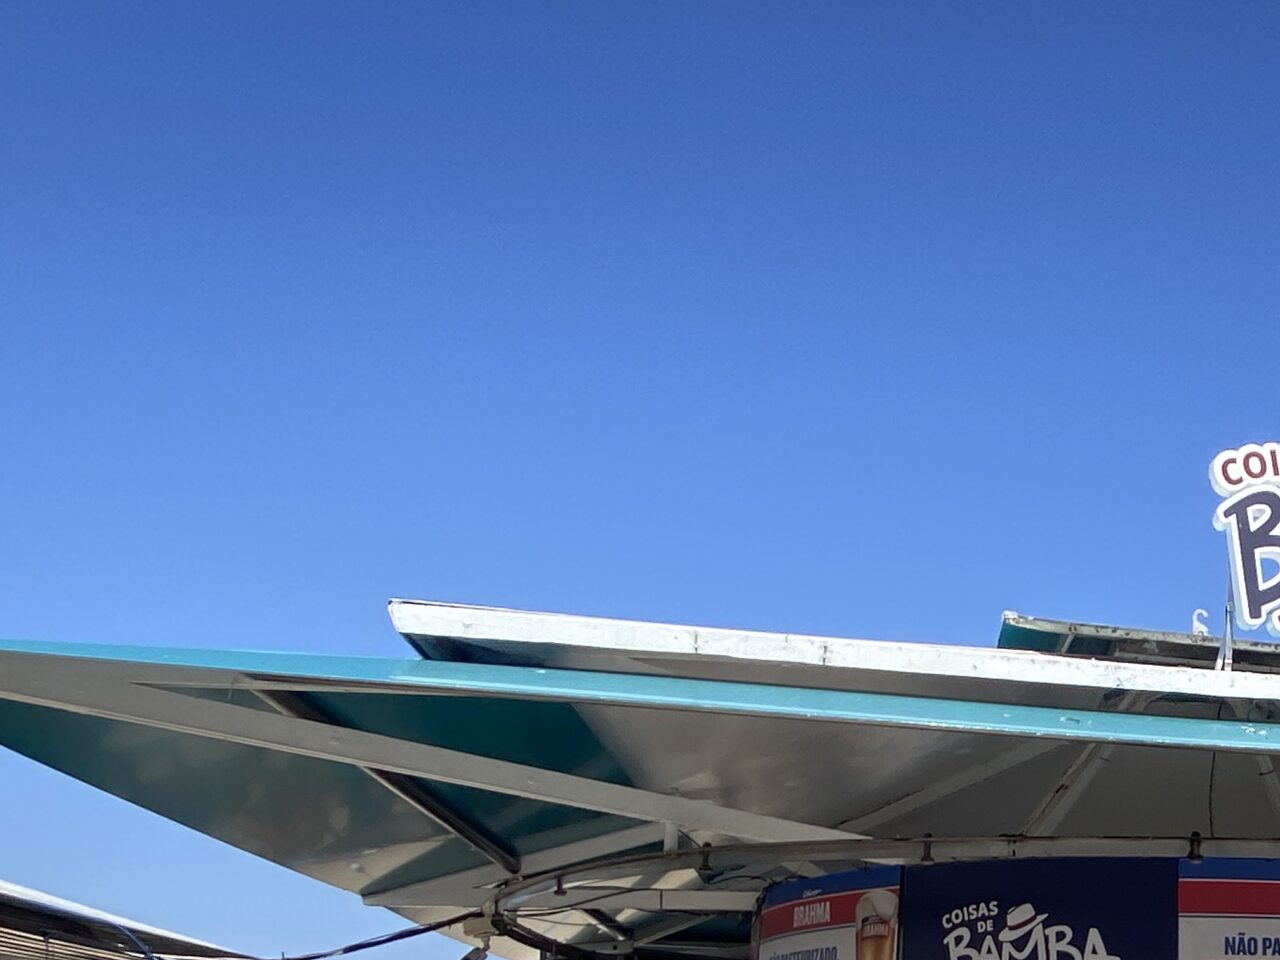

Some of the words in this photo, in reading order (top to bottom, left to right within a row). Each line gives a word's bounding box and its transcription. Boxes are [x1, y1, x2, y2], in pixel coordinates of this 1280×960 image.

[793, 901, 831, 928] BRAHMA
[942, 901, 999, 929] COISAS
[977, 919, 994, 934] DE
[1224, 932, 1258, 956] NÃO
